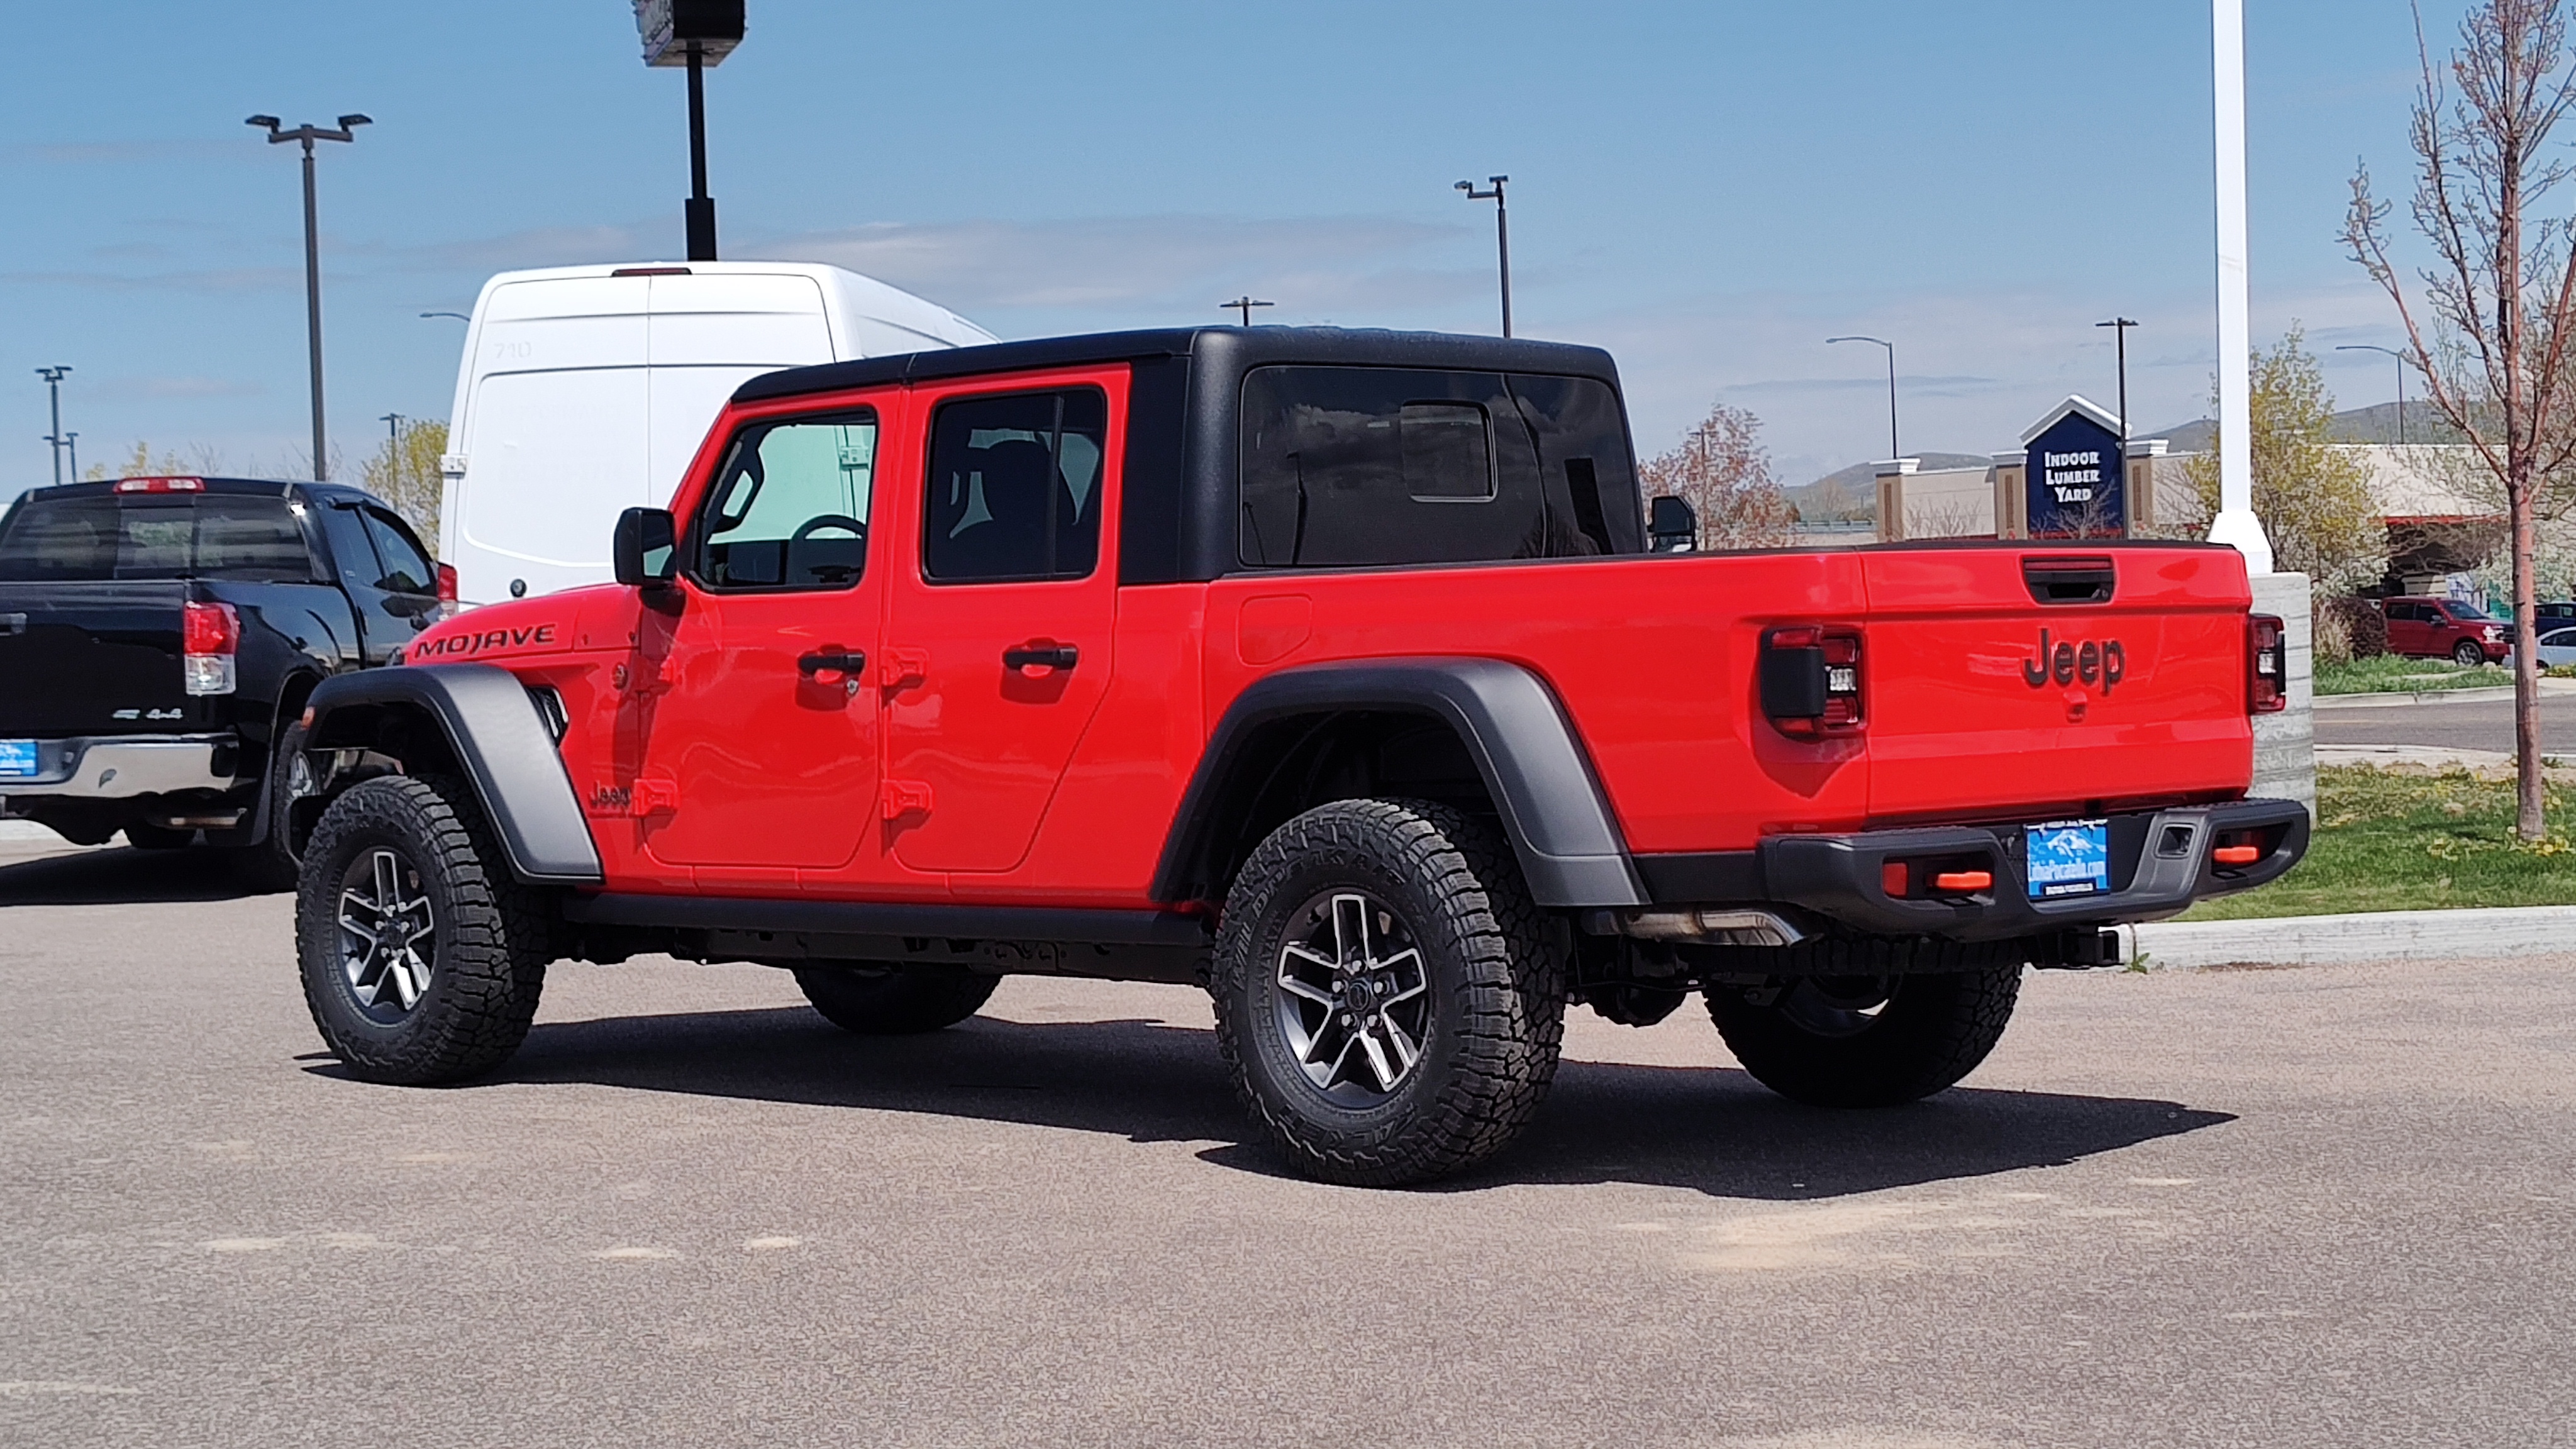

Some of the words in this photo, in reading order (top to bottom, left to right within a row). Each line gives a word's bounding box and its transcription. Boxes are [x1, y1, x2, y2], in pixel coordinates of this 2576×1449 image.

[2045, 452, 2100, 467] INDOOR
[2045, 469, 2100, 485] LUMBER
[2054, 486, 2092, 502] YARD
[415, 623, 555, 658] MOJAVE
[2023, 628, 2124, 697] Jeep
[587, 780, 631, 811] Jeep
